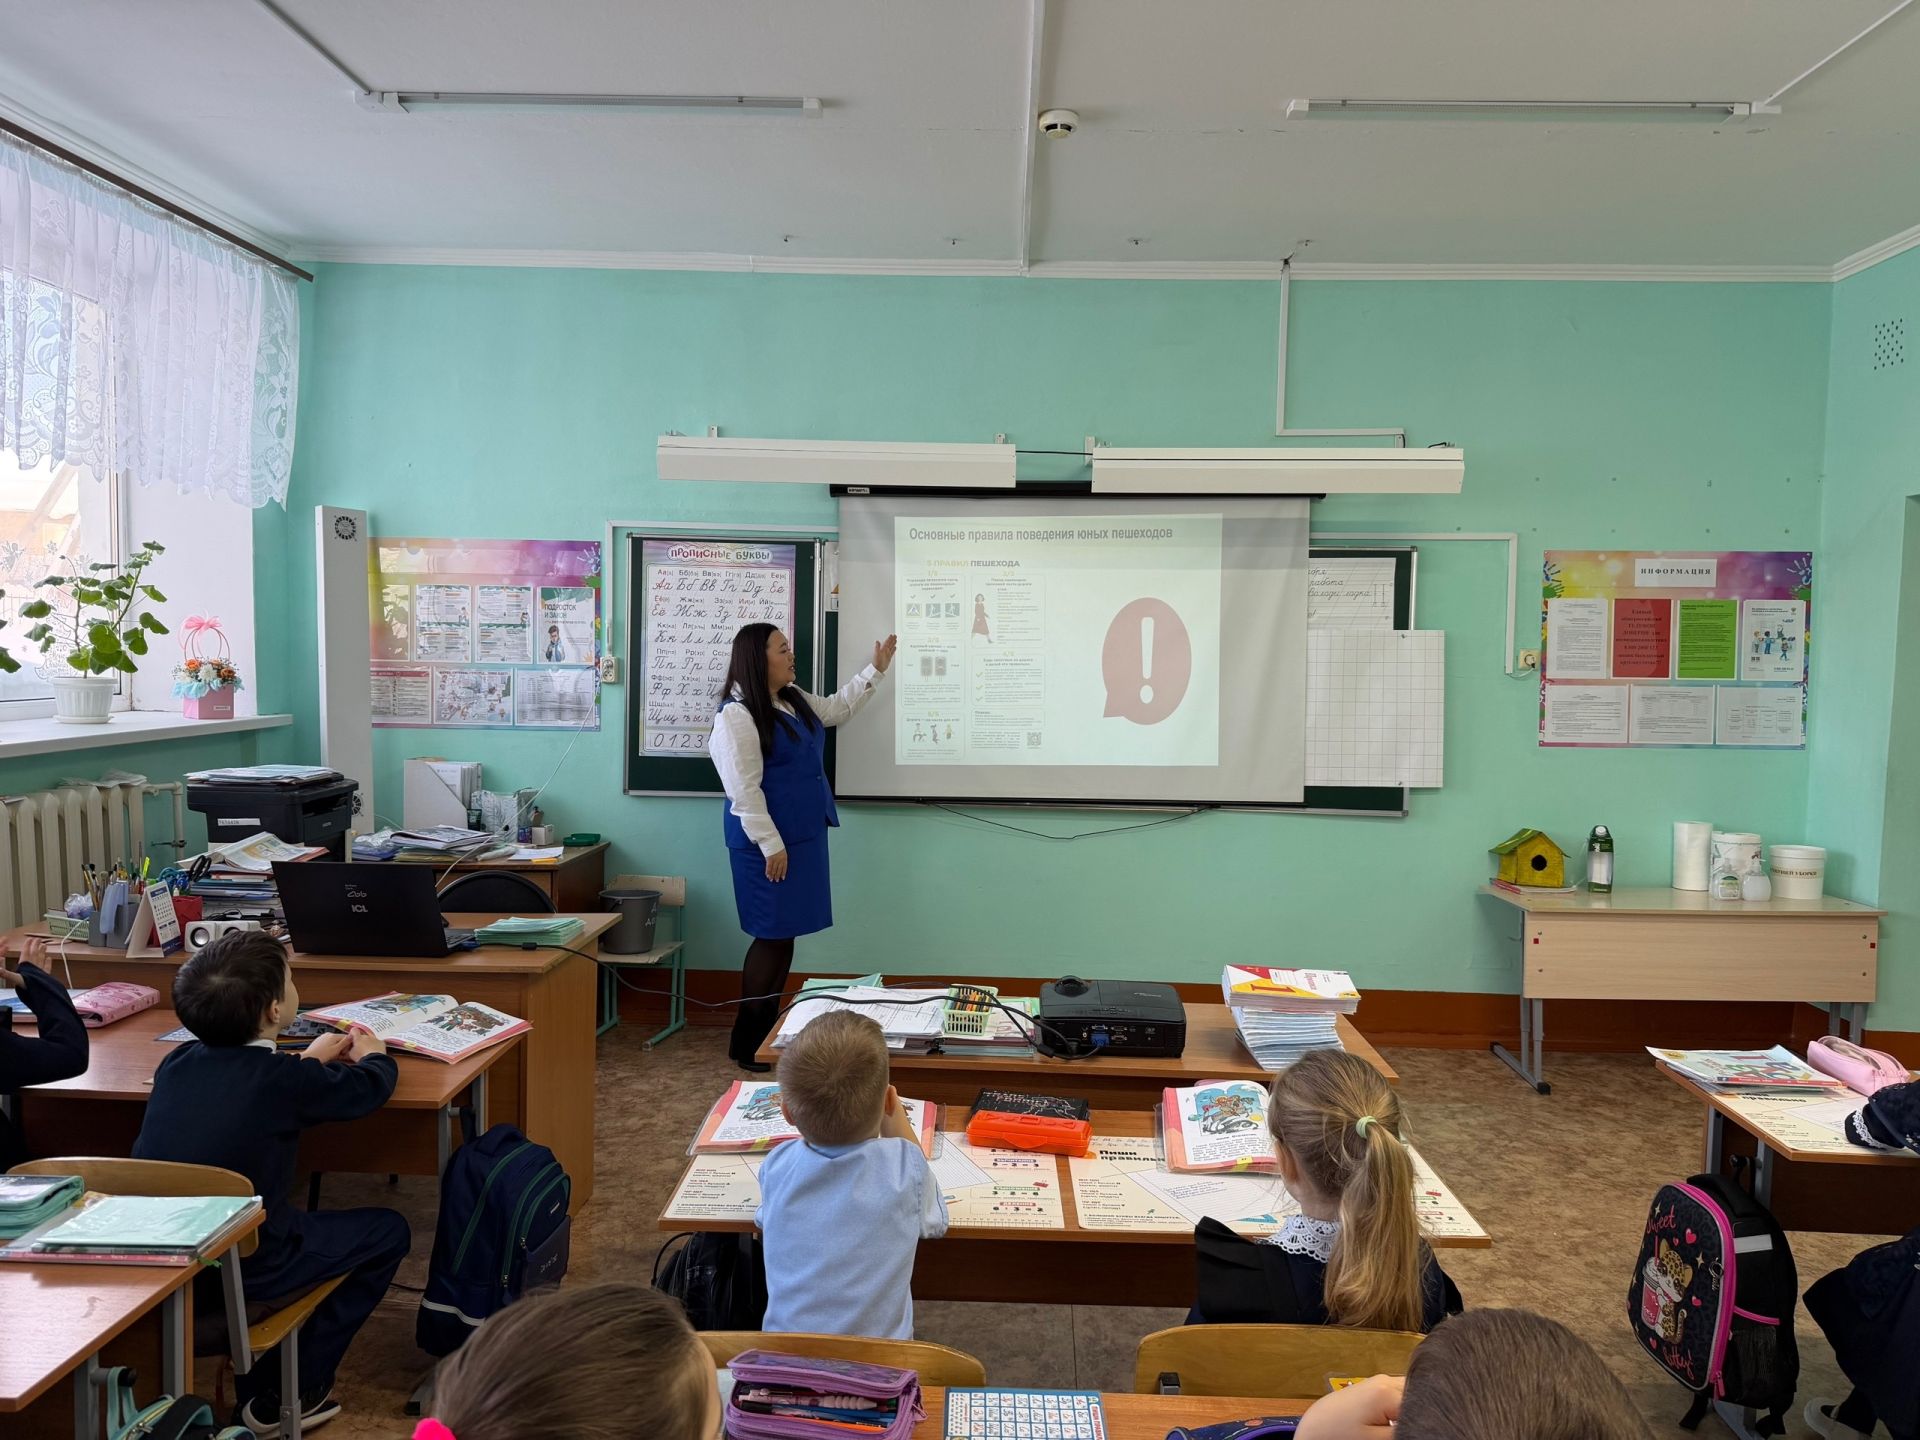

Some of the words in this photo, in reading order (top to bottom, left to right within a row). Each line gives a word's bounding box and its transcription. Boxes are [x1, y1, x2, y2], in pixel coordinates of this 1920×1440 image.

[909, 527, 965, 542] Основные
[968, 529, 1013, 543] правила
[1016, 528, 1074, 542] поведения
[1077, 528, 1108, 540] юных
[1111, 527, 1173, 540] пешеходов
[671, 547, 731, 560] ПРОПИСНЫЕ
[736, 549, 770, 560] БУКВЫ
[970, 560, 1020, 568] ПЕШЕХОДА
[1640, 567, 1711, 576] ИНФОРМАЦИЯ
[676, 578, 699, 591] Бб
[700, 579, 716, 591] Вв
[673, 604, 708, 617] Жж
[652, 656, 676, 669] Пп
[682, 657, 703, 675] Рр
[649, 682, 671, 701] Фф
[675, 682, 703, 696] Хх
[669, 733, 677, 748] 1
[680, 733, 691, 748] 2
[694, 734, 704, 749] 3
[351, 904, 369, 913] ICL
